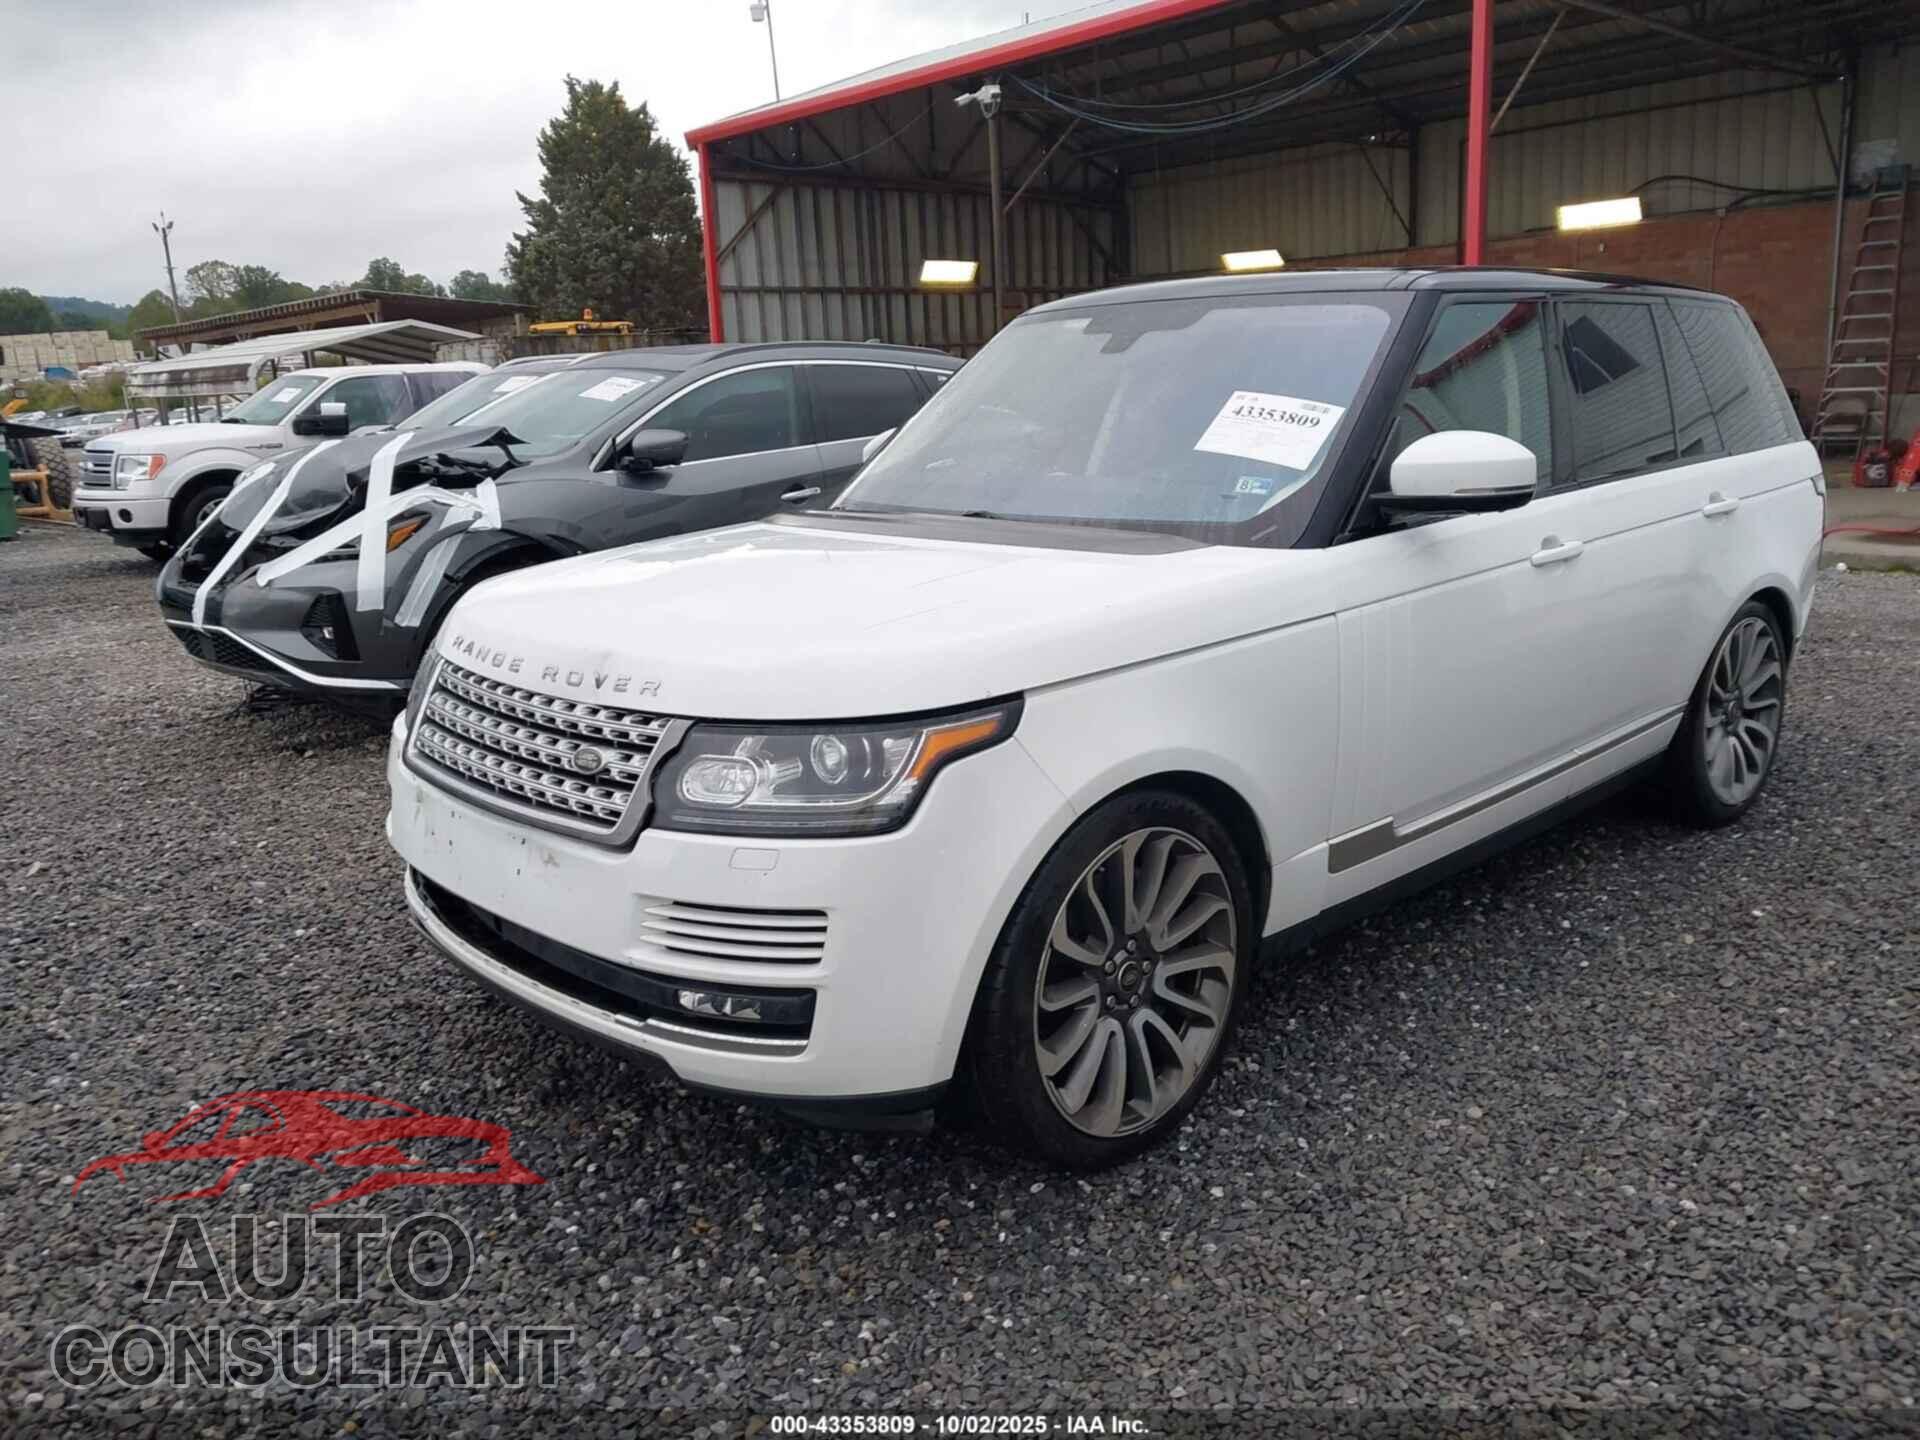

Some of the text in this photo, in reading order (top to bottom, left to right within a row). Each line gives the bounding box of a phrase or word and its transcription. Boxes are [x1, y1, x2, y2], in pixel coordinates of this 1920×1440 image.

[1232, 404, 1321, 429] 43353809
[452, 635, 662, 697] RANGE ROVER
